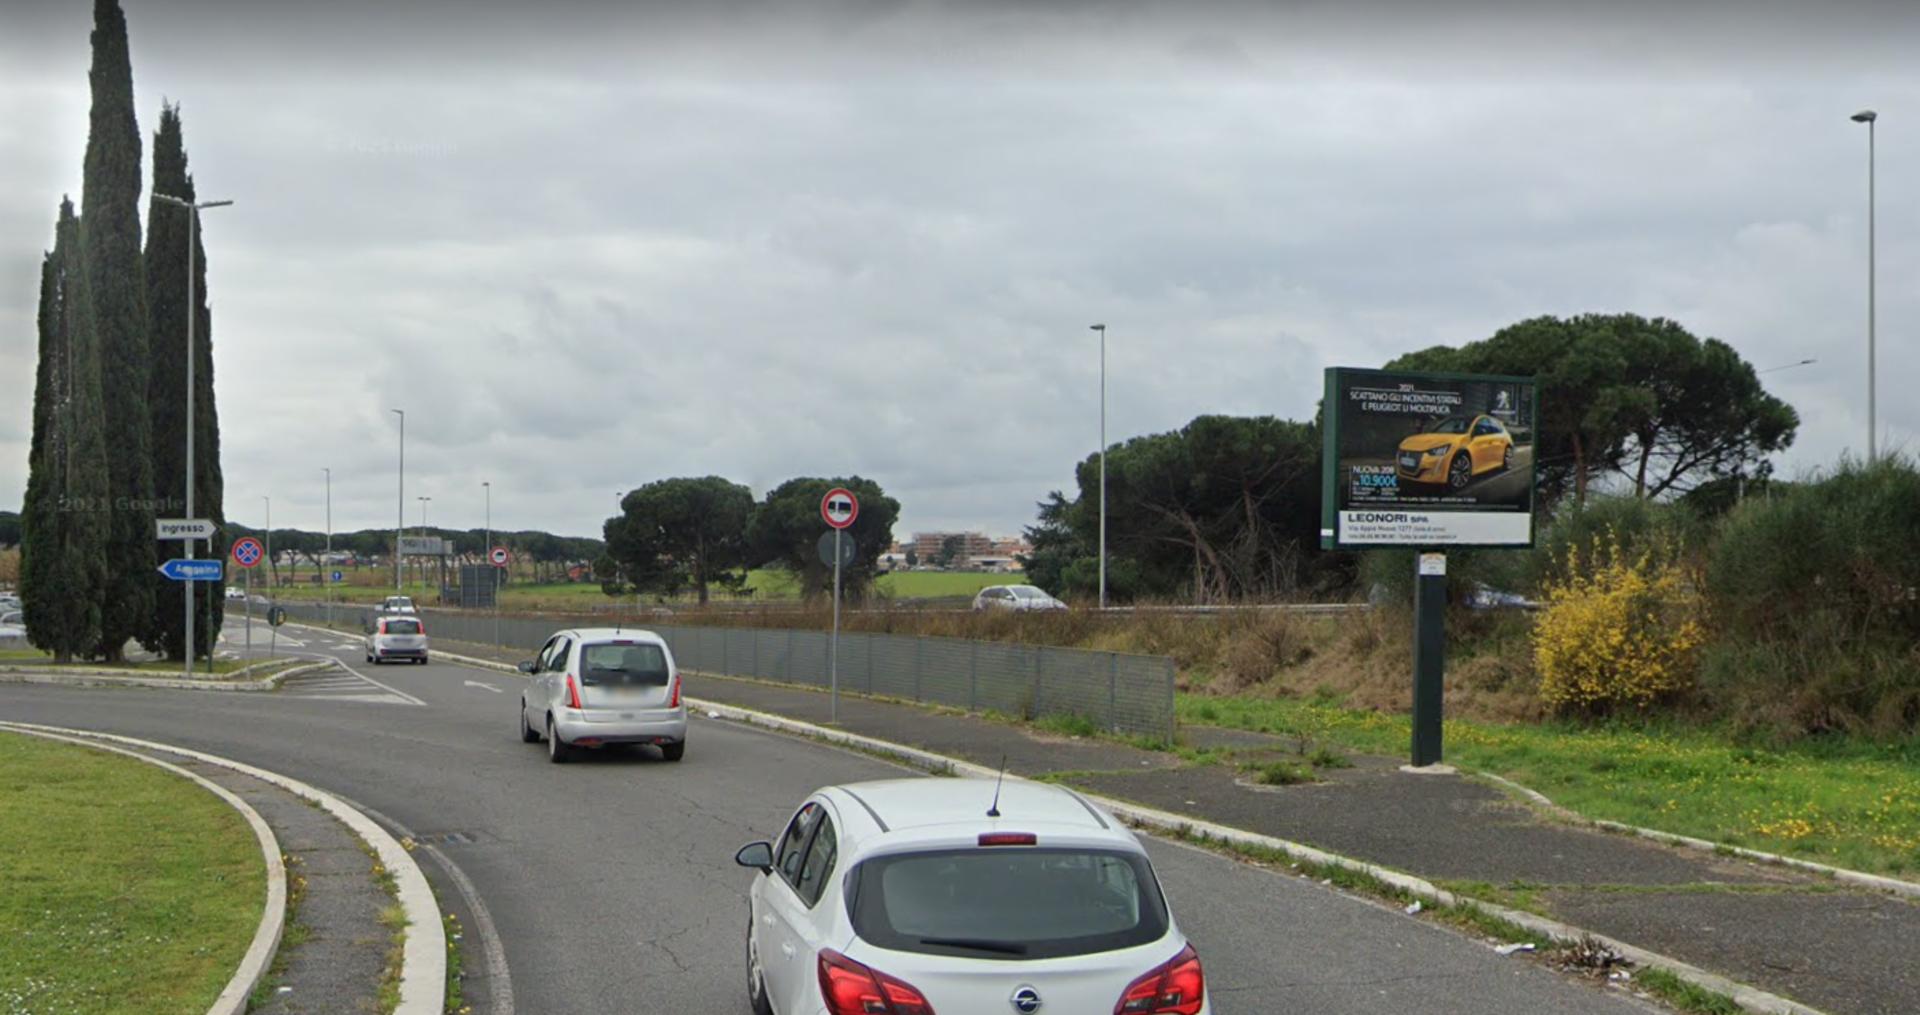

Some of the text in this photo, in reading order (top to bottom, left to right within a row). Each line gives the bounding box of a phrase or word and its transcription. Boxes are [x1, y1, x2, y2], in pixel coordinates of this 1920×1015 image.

[1349, 391, 1388, 401] SCATTANO
[1368, 402, 1401, 411] PEUGEOT
[1352, 466, 1380, 474] NUOVA
[1360, 474, 1397, 487] 10.900€
[1348, 513, 1408, 523] LEONORI
